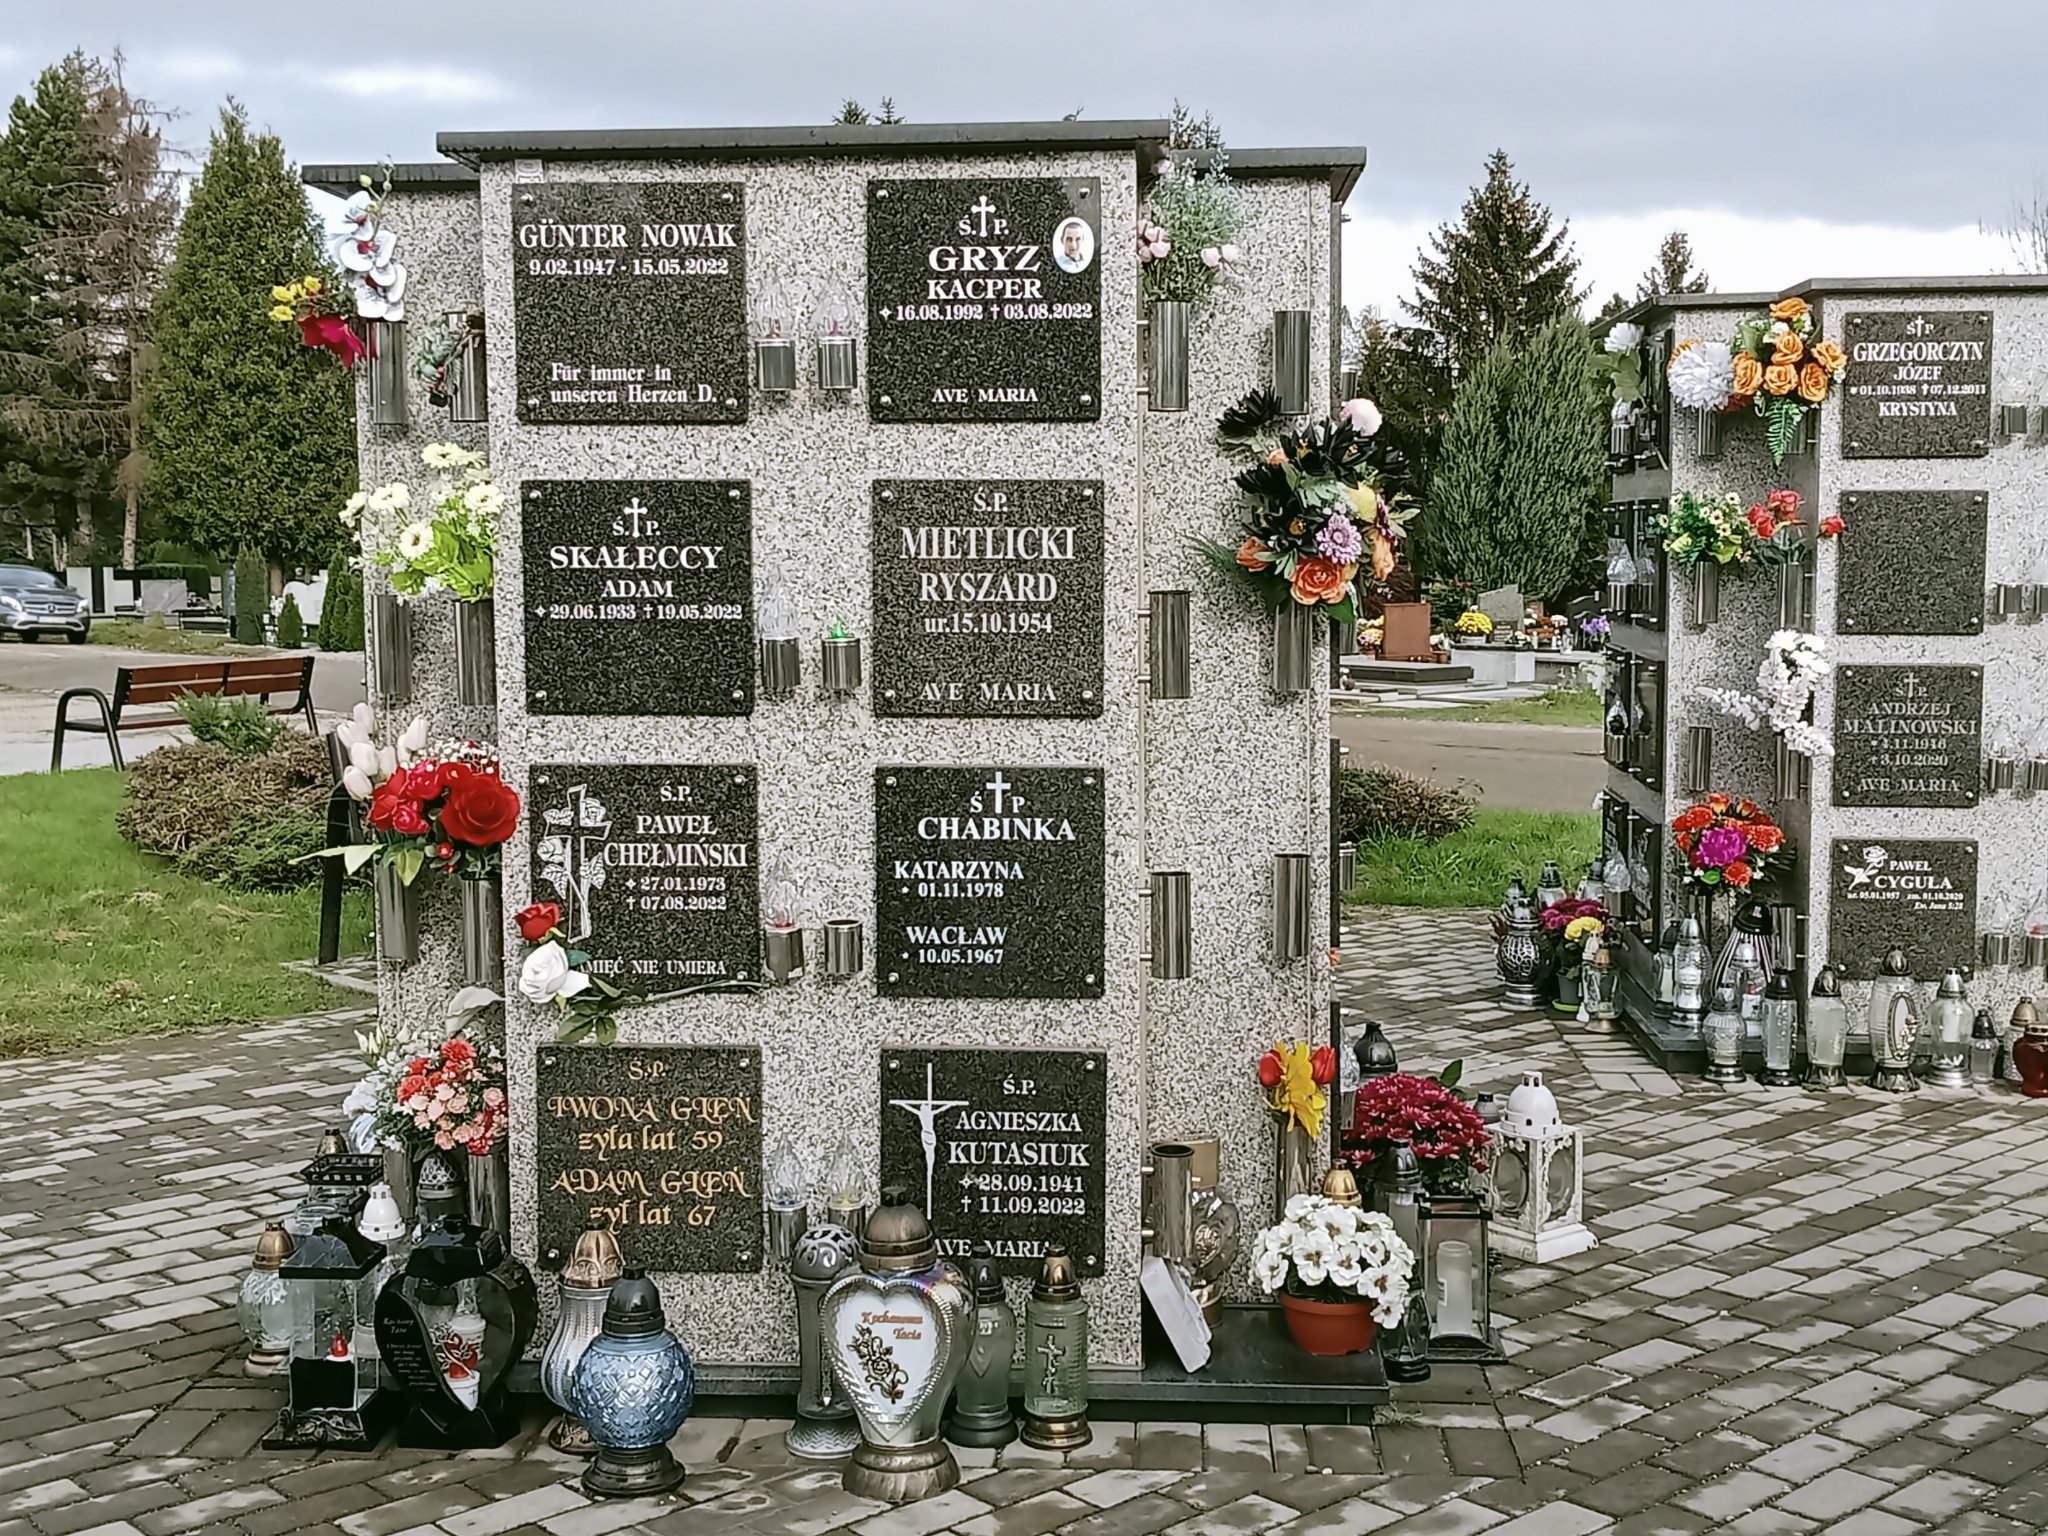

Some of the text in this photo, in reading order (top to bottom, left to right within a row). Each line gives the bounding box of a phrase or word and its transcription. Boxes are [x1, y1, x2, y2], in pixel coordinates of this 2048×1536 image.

[519, 219, 737, 248] GÜNTER NOWAK
[529, 258, 616, 276] 9.02.1947
[633, 258, 729, 275] 15.05.2022
[928, 245, 1041, 272] GRYZ
[927, 278, 1043, 300] KACPER
[896, 303, 1093, 321] 16.08.1992 03.08.2022
[1853, 341, 1985, 362] GRZEGORCZYN
[551, 362, 671, 382] Für immer in
[1893, 362, 1943, 381] JÓZEF
[550, 384, 717, 403] unseren Herzen D.
[932, 388, 1038, 403] AVE MARIA
[1878, 401, 1958, 417] KRYSTYNA
[973, 486, 1008, 512] Ś.P.
[899, 526, 1076, 560] MIETLICKI
[550, 545, 724, 570] SKAŁECCY
[601, 580, 674, 598] ADAM
[919, 572, 1058, 602] RYSZARD
[657, 604, 743, 620] 19.05.2022
[919, 683, 1057, 701] AVE MARIA
[1868, 702, 1952, 716] ANDRZEJ
[1843, 719, 1977, 735] MALINOWSKI
[660, 780, 693, 802] Ś.P.
[1901, 778, 1960, 792] MARIA
[636, 814, 718, 835] PAWEŁ
[917, 817, 1076, 841] CHABINKA
[603, 837, 748, 868] CHEŁMIŃSKI
[894, 860, 1024, 880] KATARZYNA
[640, 877, 726, 891] 27.01.1973
[918, 882, 1004, 898] 01.11.1978
[640, 896, 727, 911] 07.08.2022
[906, 926, 1007, 945] WACŁAW
[918, 949, 1003, 964] 10.05.1967
[631, 959, 659, 975] NIE
[666, 959, 727, 975] UMIERA
[1002, 1073, 1037, 1096] Ś.P.
[547, 1096, 660, 1122] IWONA
[955, 1111, 1082, 1132] AGNIESZKA
[642, 1124, 677, 1150] lat
[691, 1130, 723, 1150] 59
[947, 1141, 1091, 1167] KUTASIUK
[550, 1168, 653, 1196] ADAM
[978, 1173, 1084, 1193] 28.09.1941
[639, 1200, 671, 1225] lat
[688, 1206, 717, 1226] 67
[979, 1196, 1086, 1215] 11.09.2022
